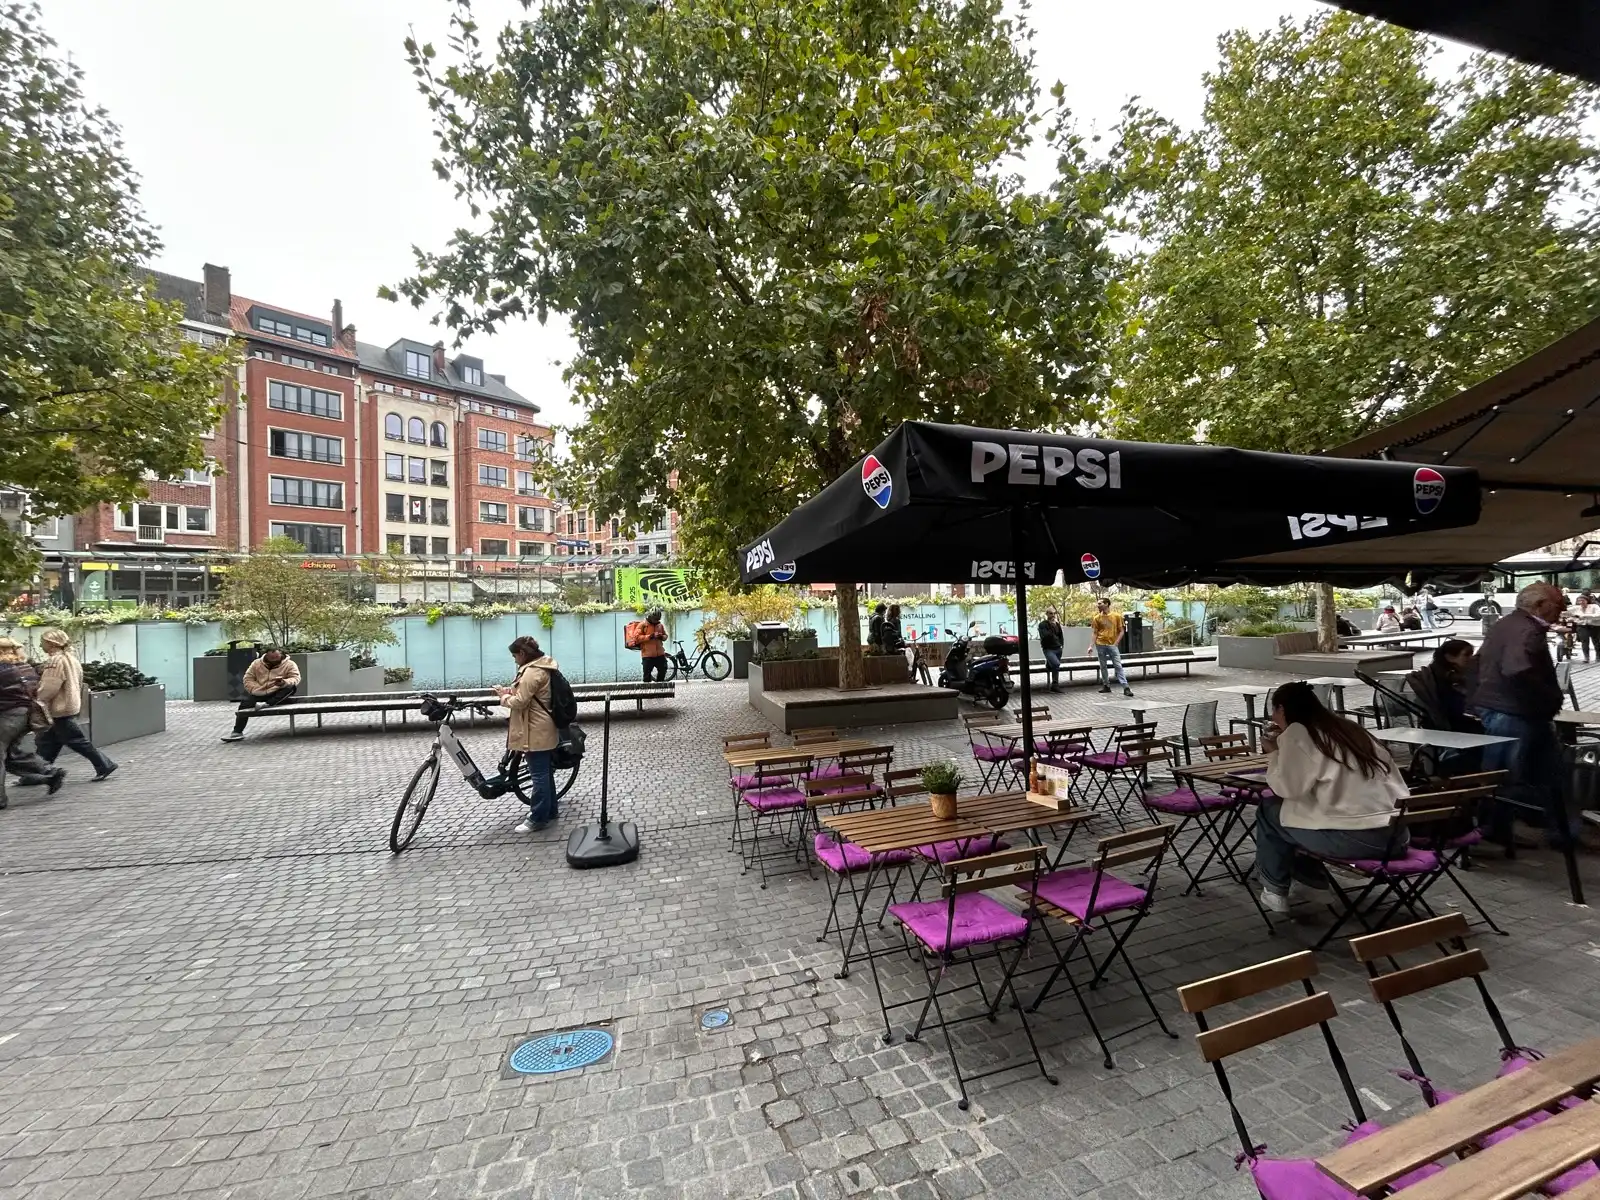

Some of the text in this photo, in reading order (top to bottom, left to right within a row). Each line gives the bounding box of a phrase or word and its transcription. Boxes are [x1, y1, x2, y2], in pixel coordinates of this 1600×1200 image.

[971, 441, 1121, 489] PEPSI
[864, 471, 890, 493] PEPSI
[1416, 483, 1444, 496] PEPSI
[746, 538, 775, 573] PEPSI
